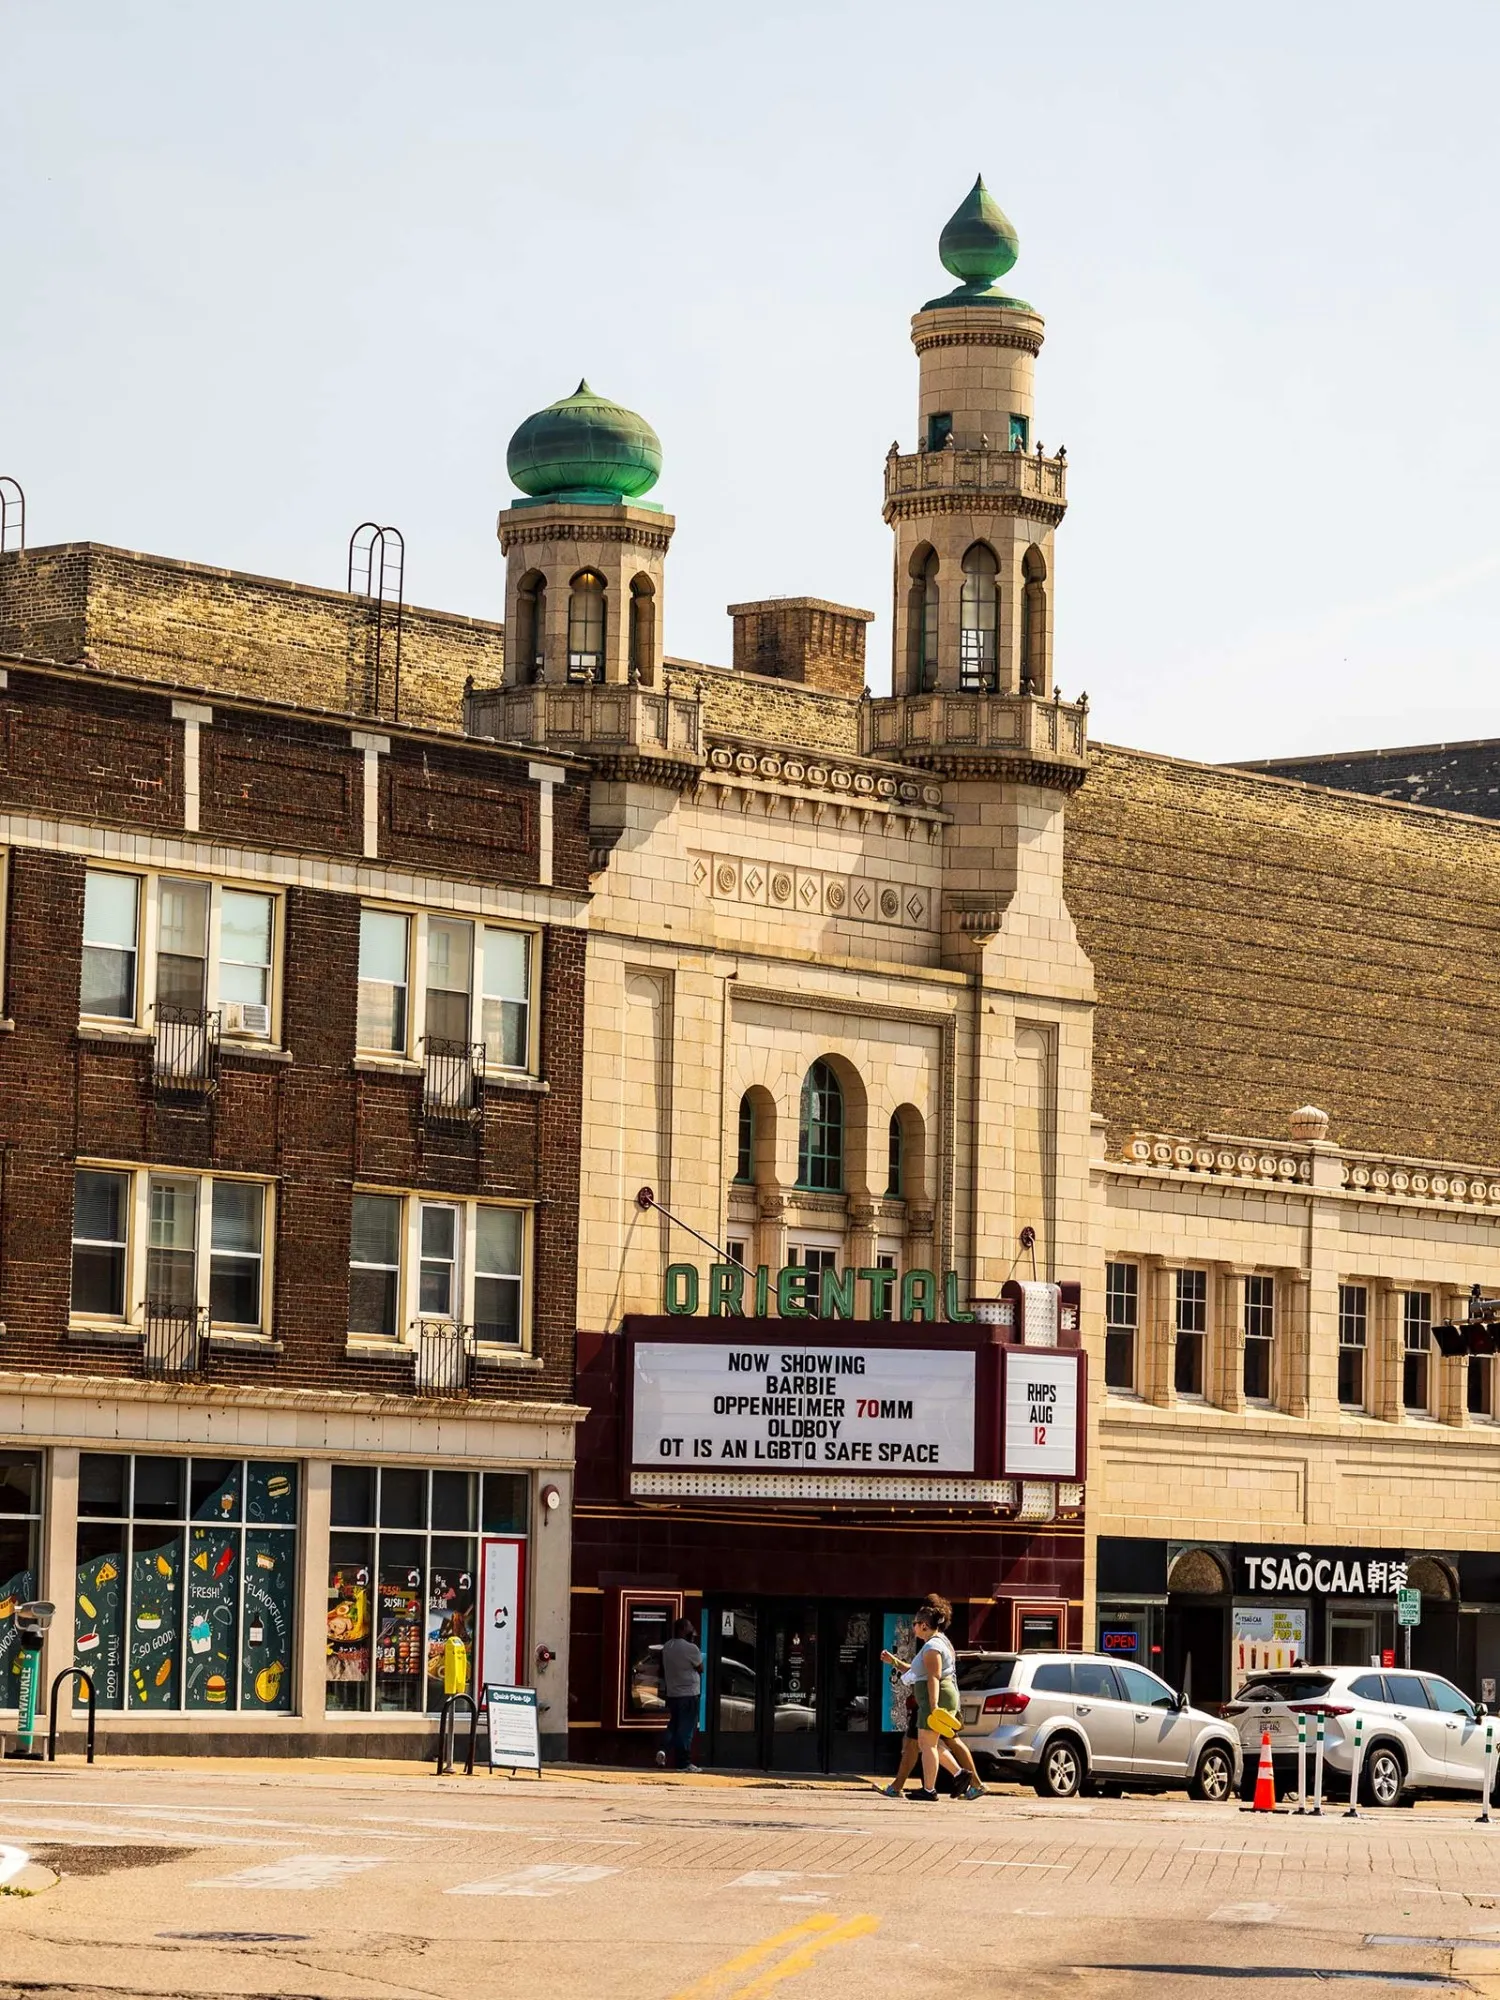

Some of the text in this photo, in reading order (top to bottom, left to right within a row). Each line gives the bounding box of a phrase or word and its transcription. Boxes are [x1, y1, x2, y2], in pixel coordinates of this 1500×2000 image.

[664, 1263, 976, 1322] ORIENTAL
[728, 1353, 865, 1374] NOW SHOWING
[766, 1376, 836, 1395] BARBIE
[1028, 1384, 1056, 1402] RHPS
[713, 1396, 913, 1418] OPPENHEIMER 70MM
[1030, 1405, 1053, 1424] AUG
[768, 1419, 841, 1438] OLDBOY
[1034, 1427, 1046, 1445] 12
[659, 1438, 939, 1463] OT IS AN LGBTQ SAFE SPACE
[191, 1586, 220, 1598] FRESH!
[247, 1583, 286, 1637] FLAVORFUL!
[384, 1598, 405, 1608] SUSHI
[725, 1615, 732, 1627] A
[139, 1629, 177, 1657] SO GOOD!
[1105, 1634, 1136, 1648] OPEN
[106, 1634, 118, 1699] FOOD HALL!
[17, 1667, 31, 1731] VIEWAUKEE
[493, 1692, 509, 1701] Quick
